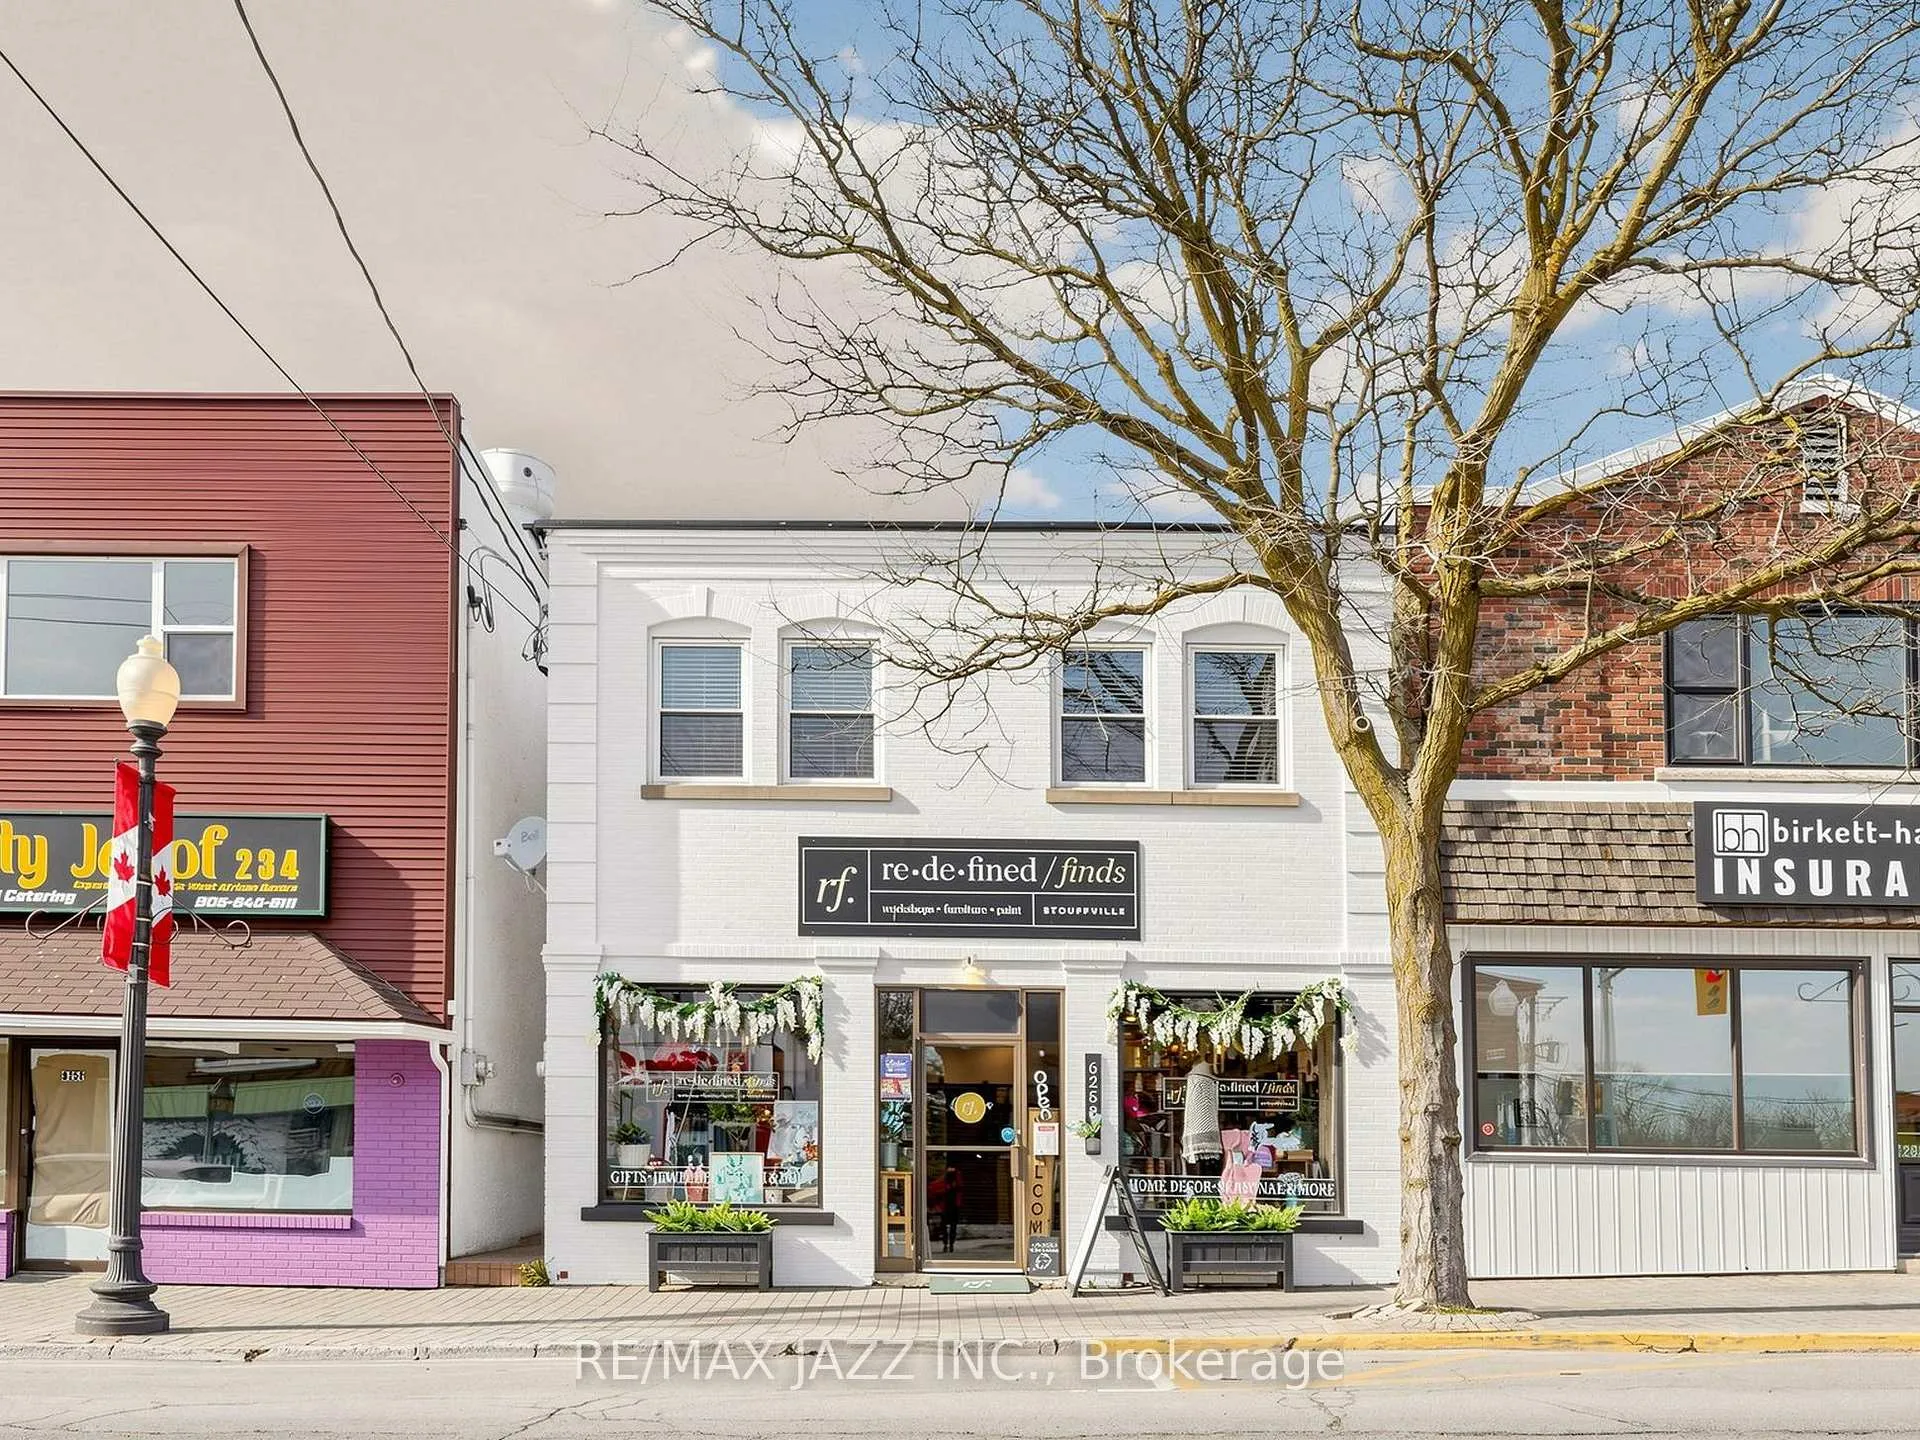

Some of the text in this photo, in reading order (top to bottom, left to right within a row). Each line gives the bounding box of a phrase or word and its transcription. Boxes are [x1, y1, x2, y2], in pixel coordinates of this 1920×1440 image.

[70, 823, 229, 880] Joof
[235, 848, 299, 880] 234
[1713, 858, 1909, 897] INSURA
[4, 889, 77, 905] Catering
[1043, 906, 1125, 916] STOUFFVILLE
